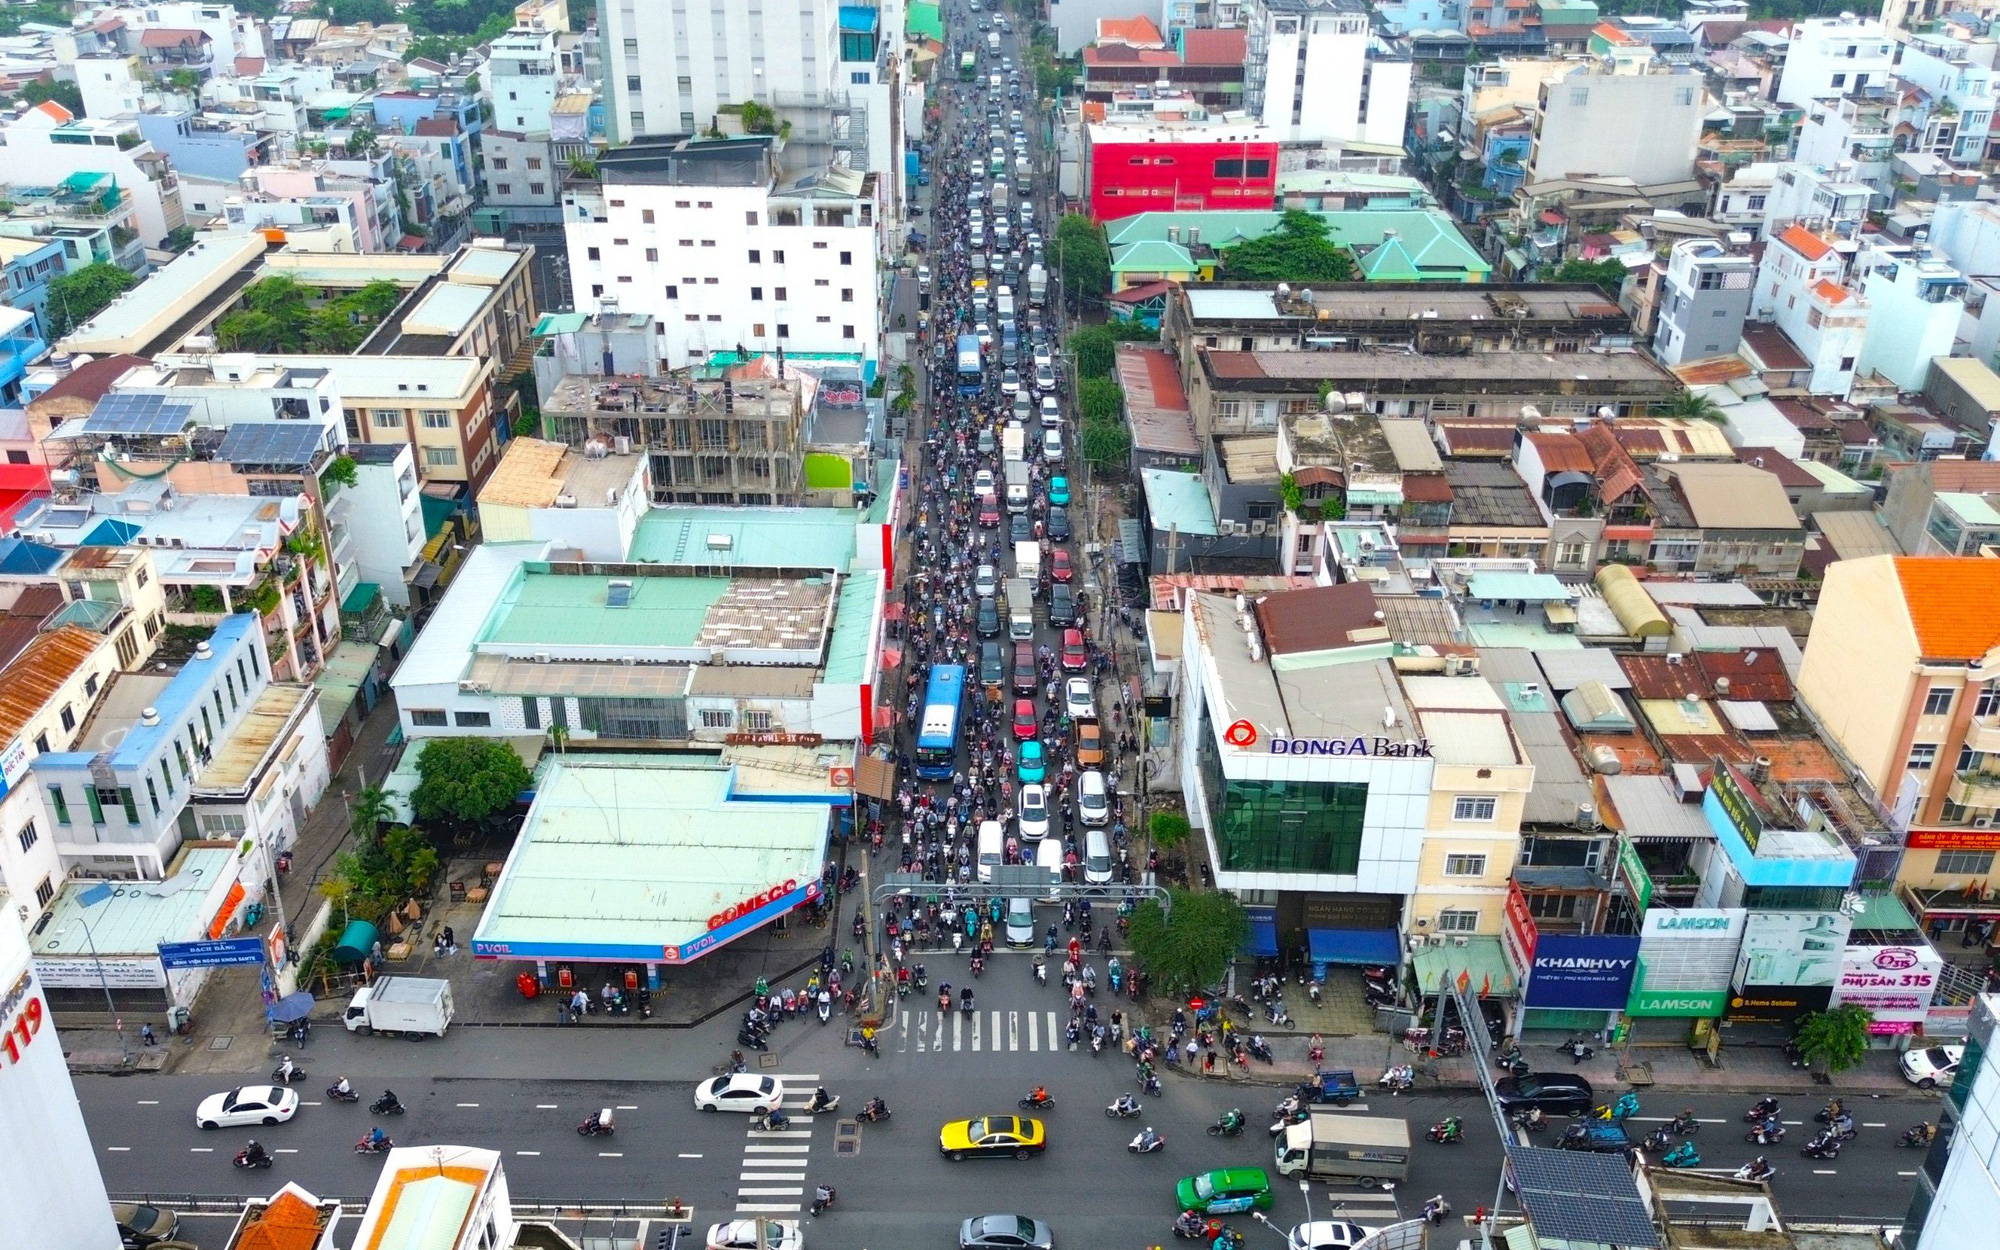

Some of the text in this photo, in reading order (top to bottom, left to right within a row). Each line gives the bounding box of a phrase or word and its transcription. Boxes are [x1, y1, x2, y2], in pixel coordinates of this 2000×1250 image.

[1271, 737, 1437, 758] DONGA Bank
[1656, 917, 1730, 930] LAMSON
[476, 943, 512, 953] PVOIL
[686, 935, 717, 955] PVOIL
[1534, 957, 1633, 970] KHANHVY
[1842, 974, 1932, 988] PHỤ SẢN 315
[1640, 999, 1713, 1010] LAMSON
